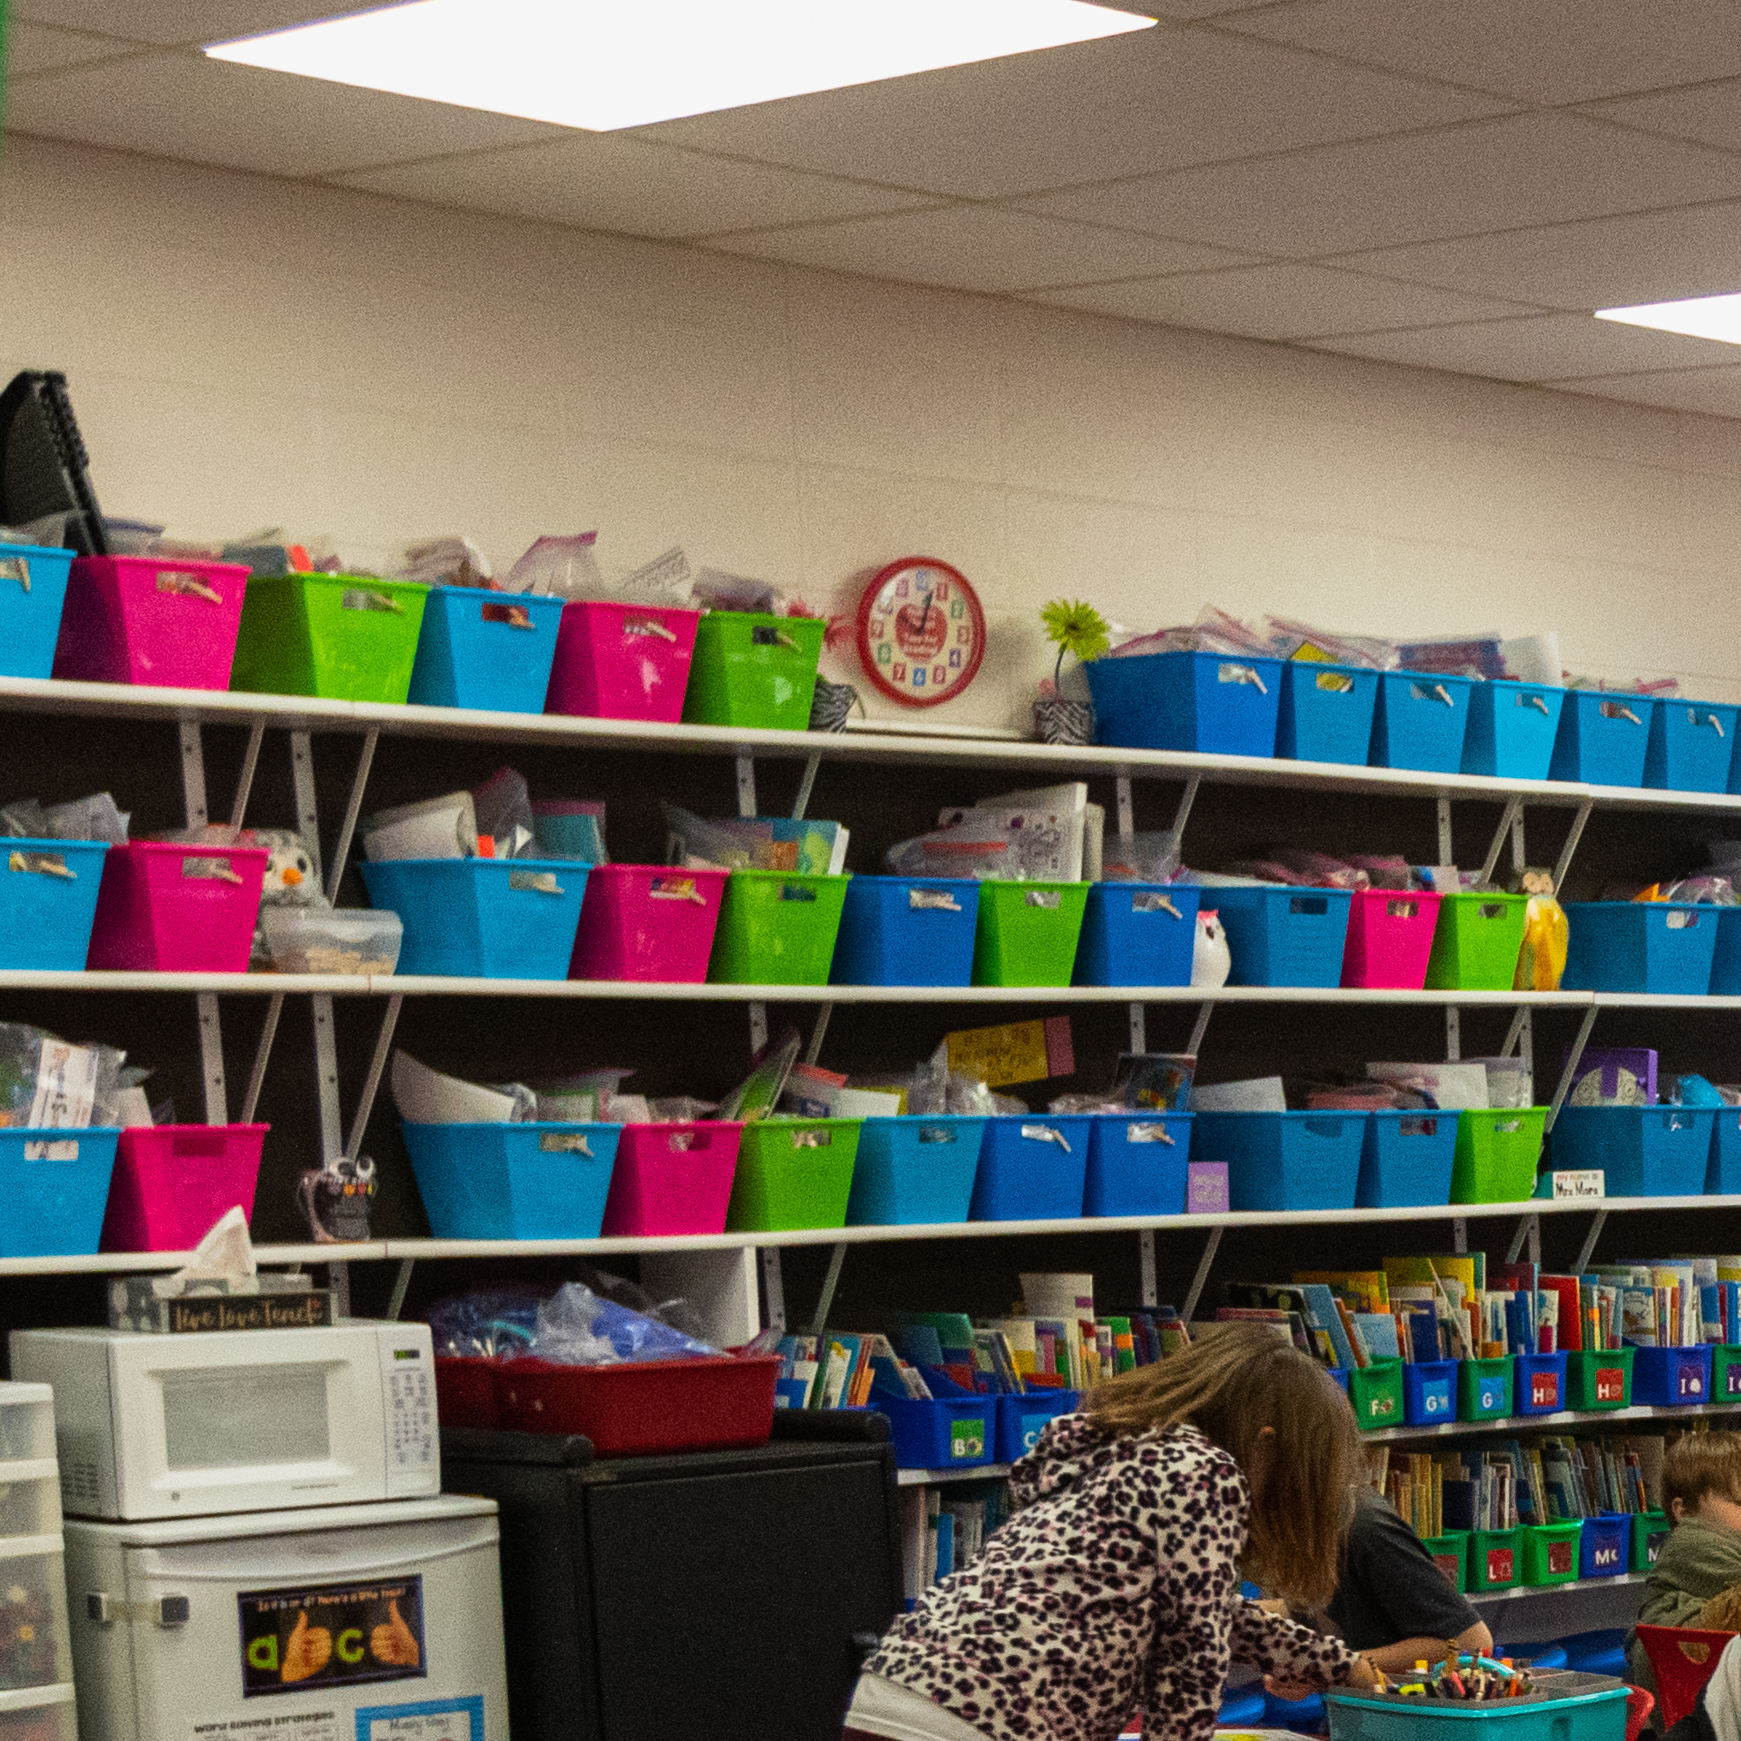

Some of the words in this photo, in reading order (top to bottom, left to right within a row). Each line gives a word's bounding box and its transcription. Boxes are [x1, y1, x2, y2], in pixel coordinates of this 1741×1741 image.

[1482, 1392, 1493, 1408] G
[1534, 1388, 1544, 1404] H
[1598, 1384, 1609, 1400] H
[1426, 1396, 1437, 1412] G
[953, 1438, 967, 1457] B
